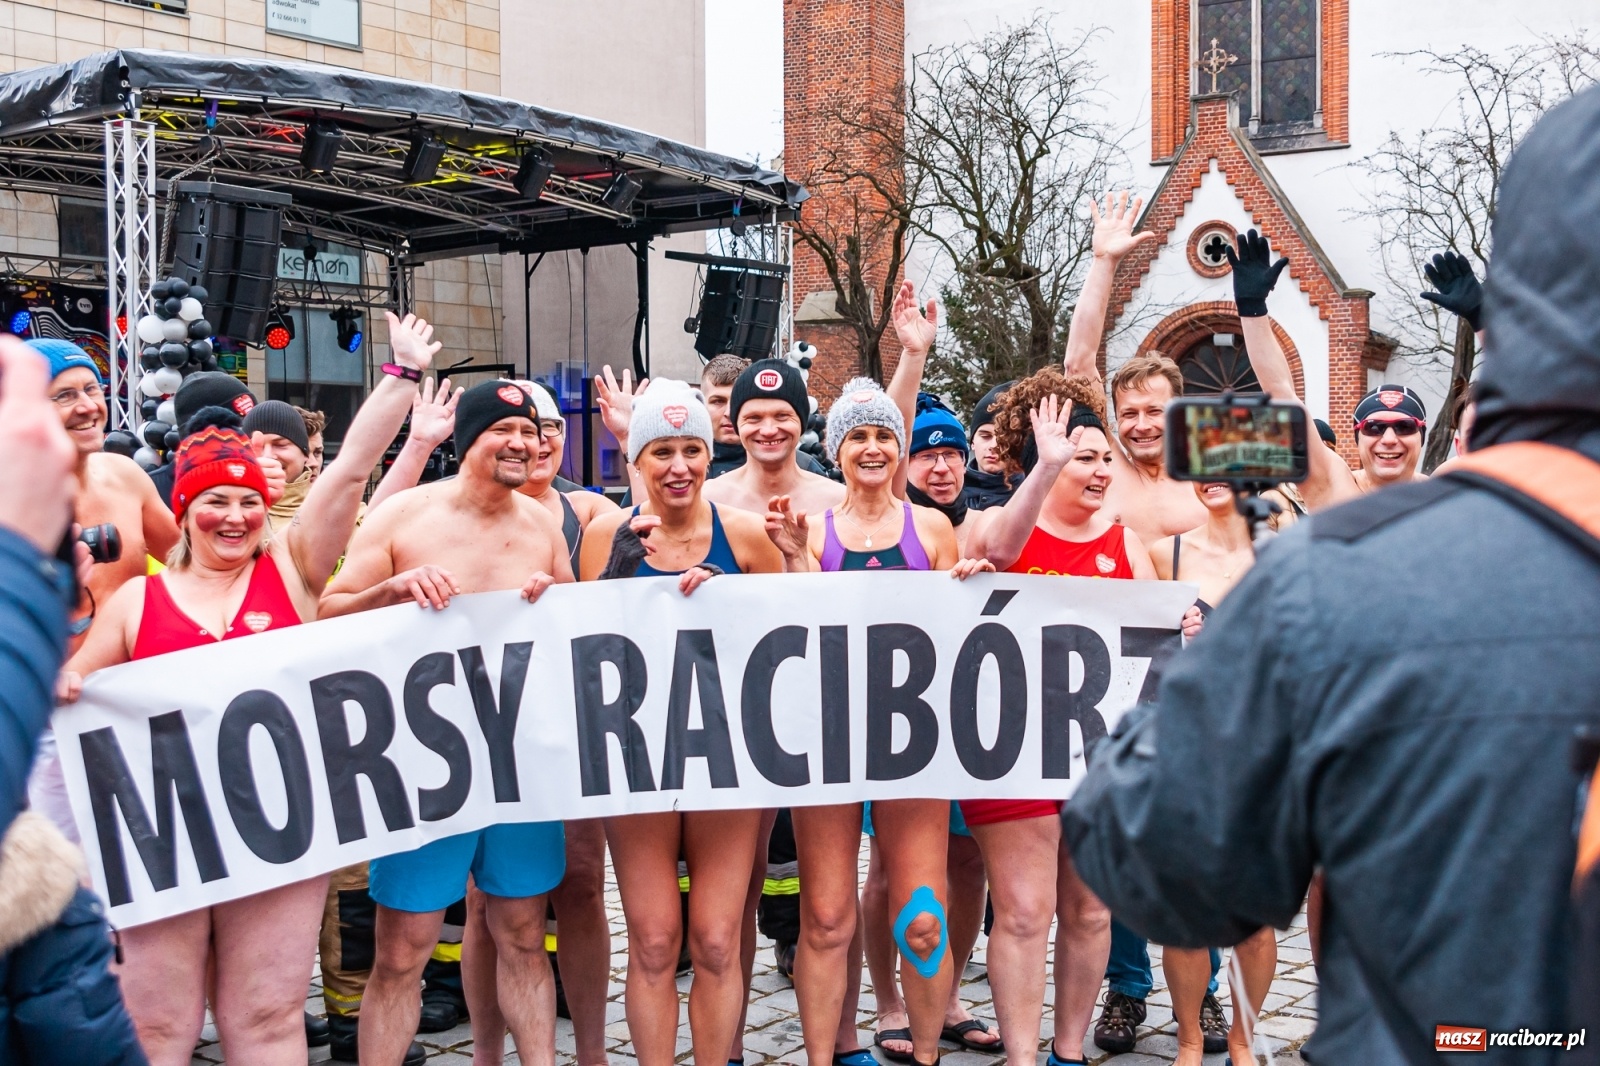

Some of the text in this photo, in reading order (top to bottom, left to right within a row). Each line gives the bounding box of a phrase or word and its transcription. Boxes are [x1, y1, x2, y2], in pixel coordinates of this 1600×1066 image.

[272, 0, 297, 9] adwokat
[761, 375, 777, 385] FIAT
[79, 641, 535, 907] MORSY
